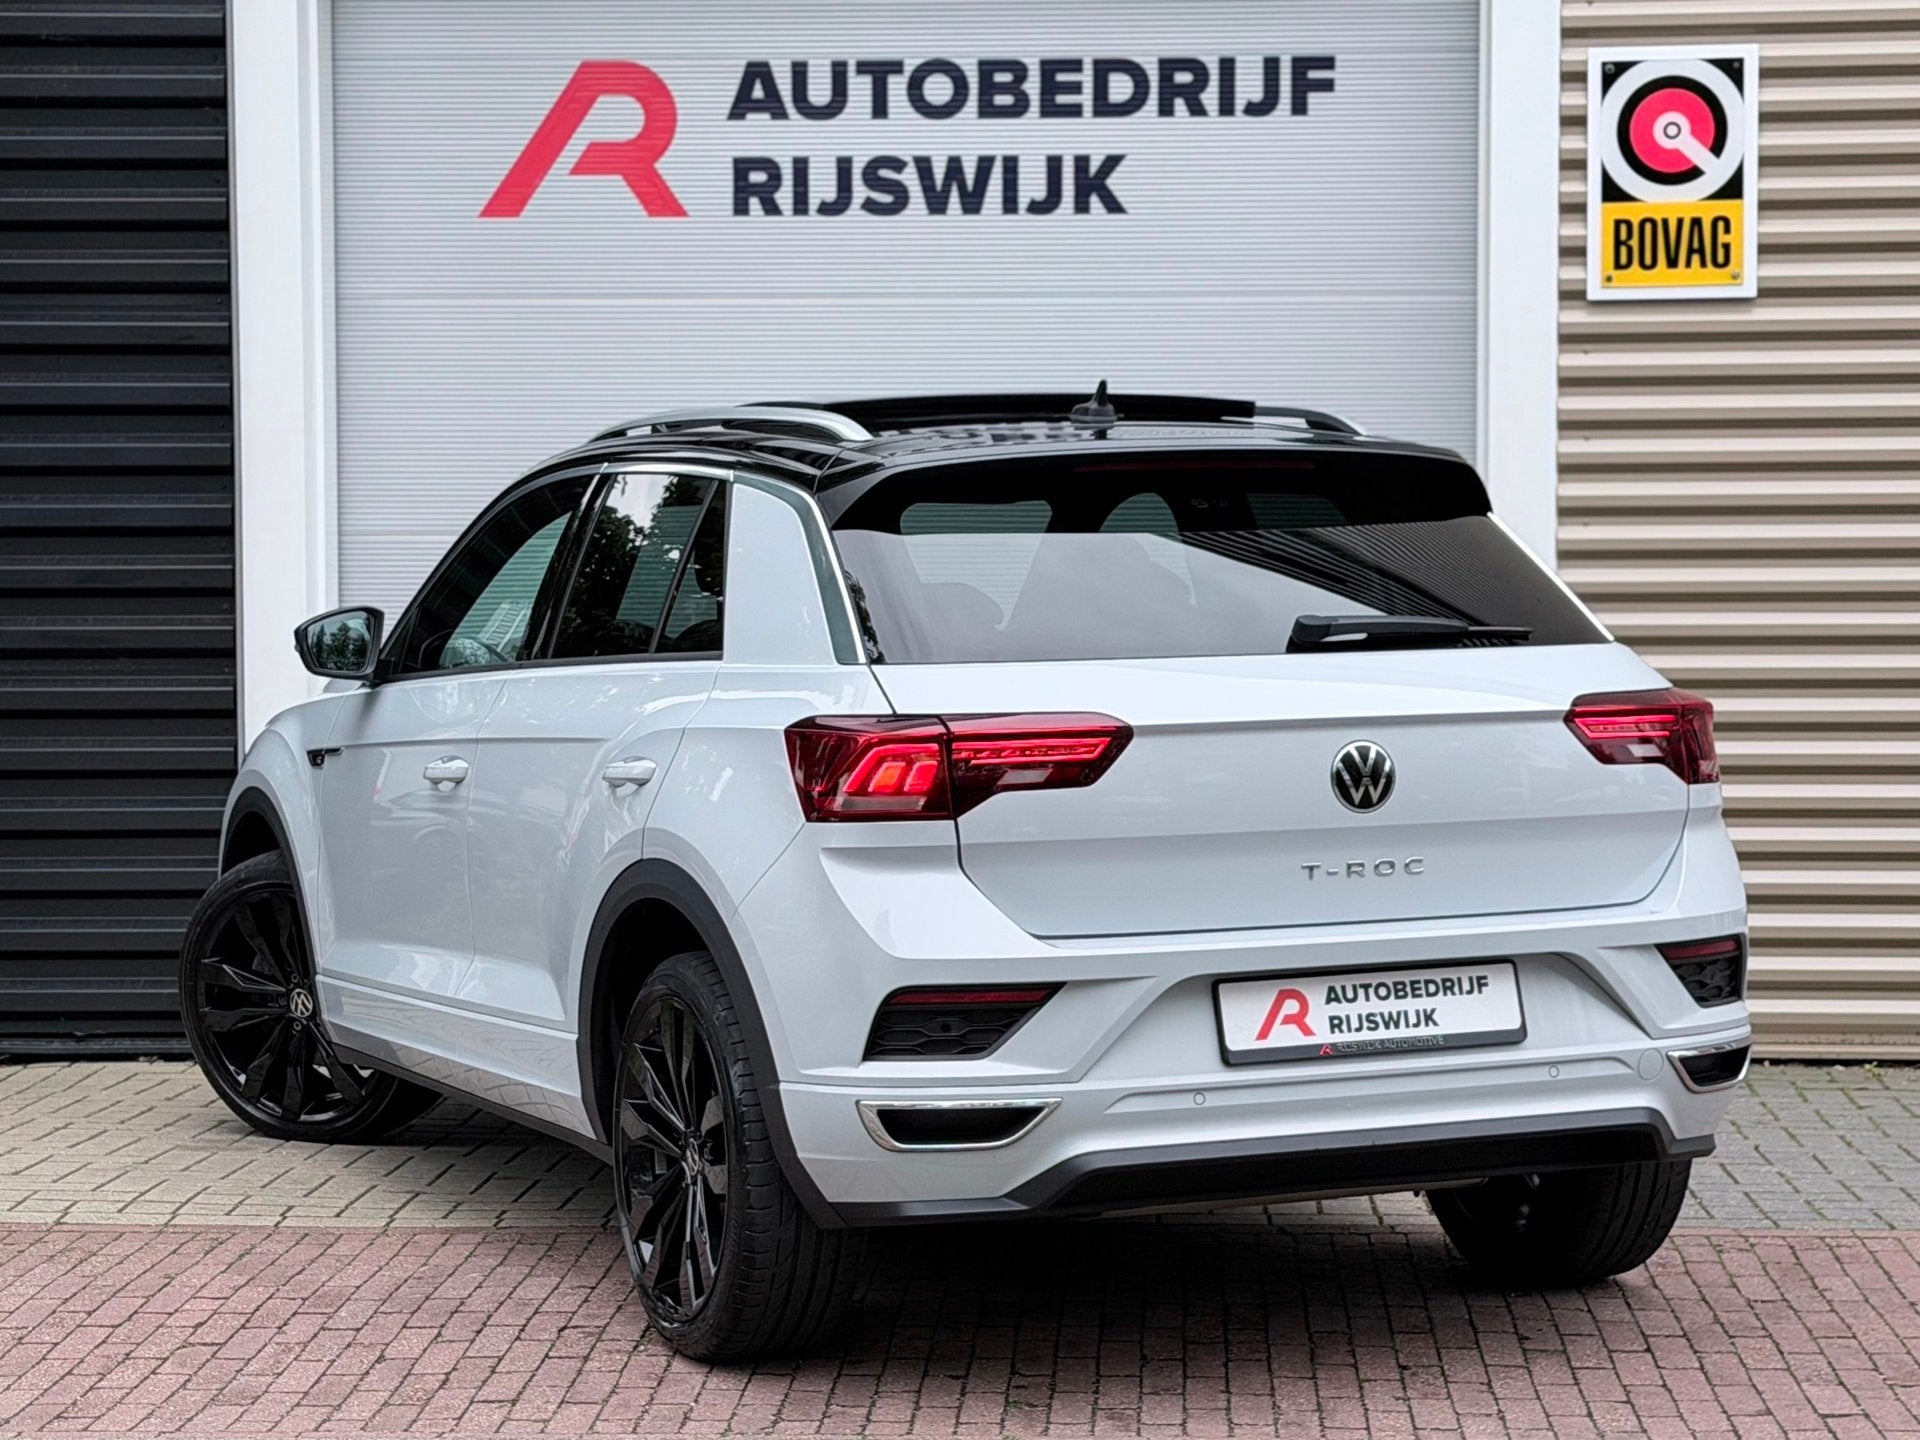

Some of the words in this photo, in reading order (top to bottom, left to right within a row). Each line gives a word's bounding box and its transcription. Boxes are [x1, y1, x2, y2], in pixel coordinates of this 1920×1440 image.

[727, 55, 1336, 121] AUTOBEDRIJF
[732, 154, 1128, 217] RIJSWIJK
[1613, 215, 1731, 270] BOVAG
[1301, 857, 1424, 880] T-ROC
[1325, 975, 1489, 1005] AUTOBEDRIJF
[1328, 1008, 1440, 1034] RIJSWIJK
